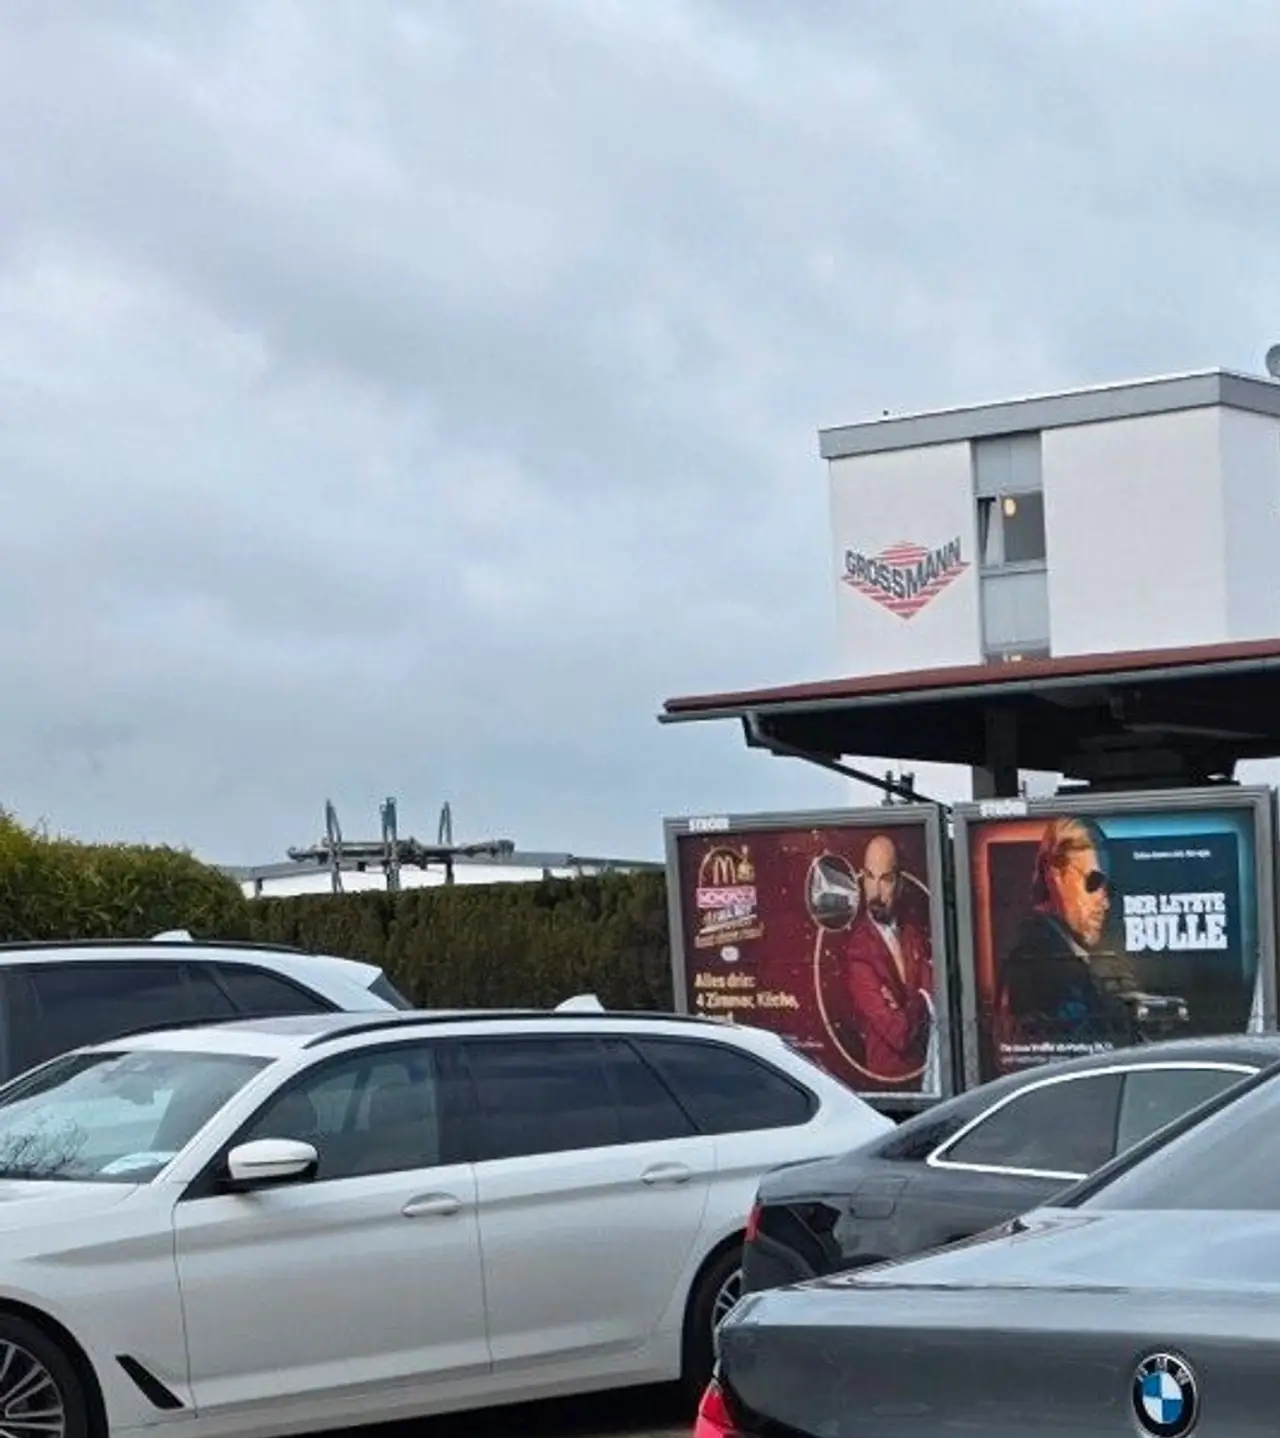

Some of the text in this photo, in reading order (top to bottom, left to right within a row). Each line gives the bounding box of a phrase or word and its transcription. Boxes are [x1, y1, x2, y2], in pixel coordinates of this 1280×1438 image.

[845, 536, 961, 599] GROSSMANN
[1123, 892, 1226, 915] DER LETZTE
[1124, 914, 1229, 951] BULLE
[695, 972, 725, 988] Alles
